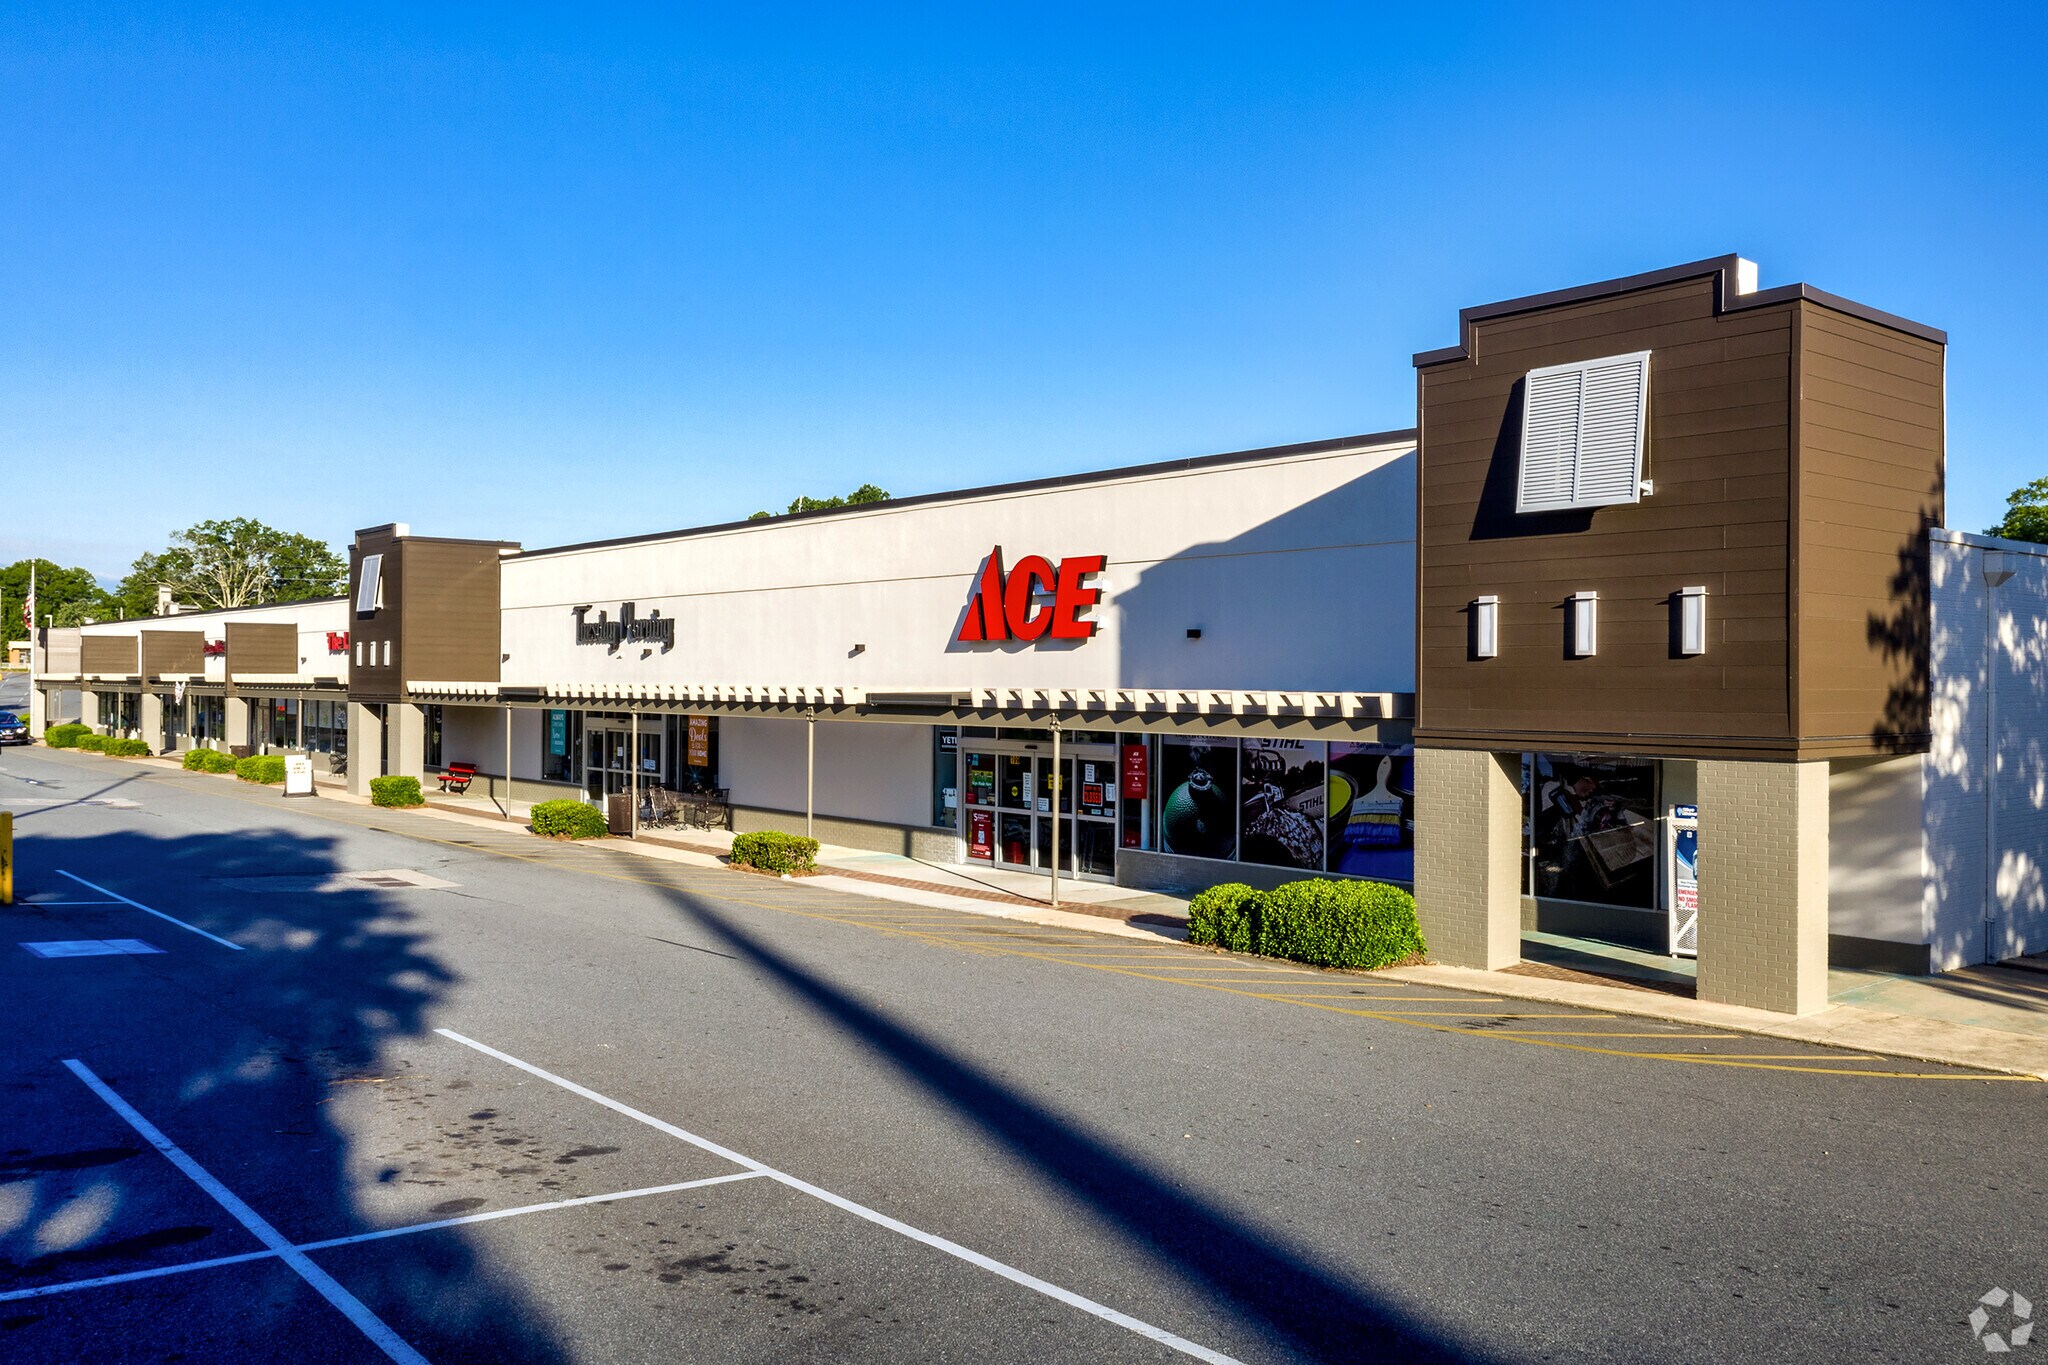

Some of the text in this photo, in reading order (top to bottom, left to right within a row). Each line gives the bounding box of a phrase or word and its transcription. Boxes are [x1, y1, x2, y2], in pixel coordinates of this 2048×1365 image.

[957, 545, 1108, 641] ACE
[573, 601, 676, 653] Tuesday Morning
[326, 631, 343, 650] The
[942, 735, 957, 745] YETI
[1261, 737, 1305, 750] STIHL
[1084, 791, 1101, 804] CLOSED
[1299, 795, 1325, 810] STIHL
